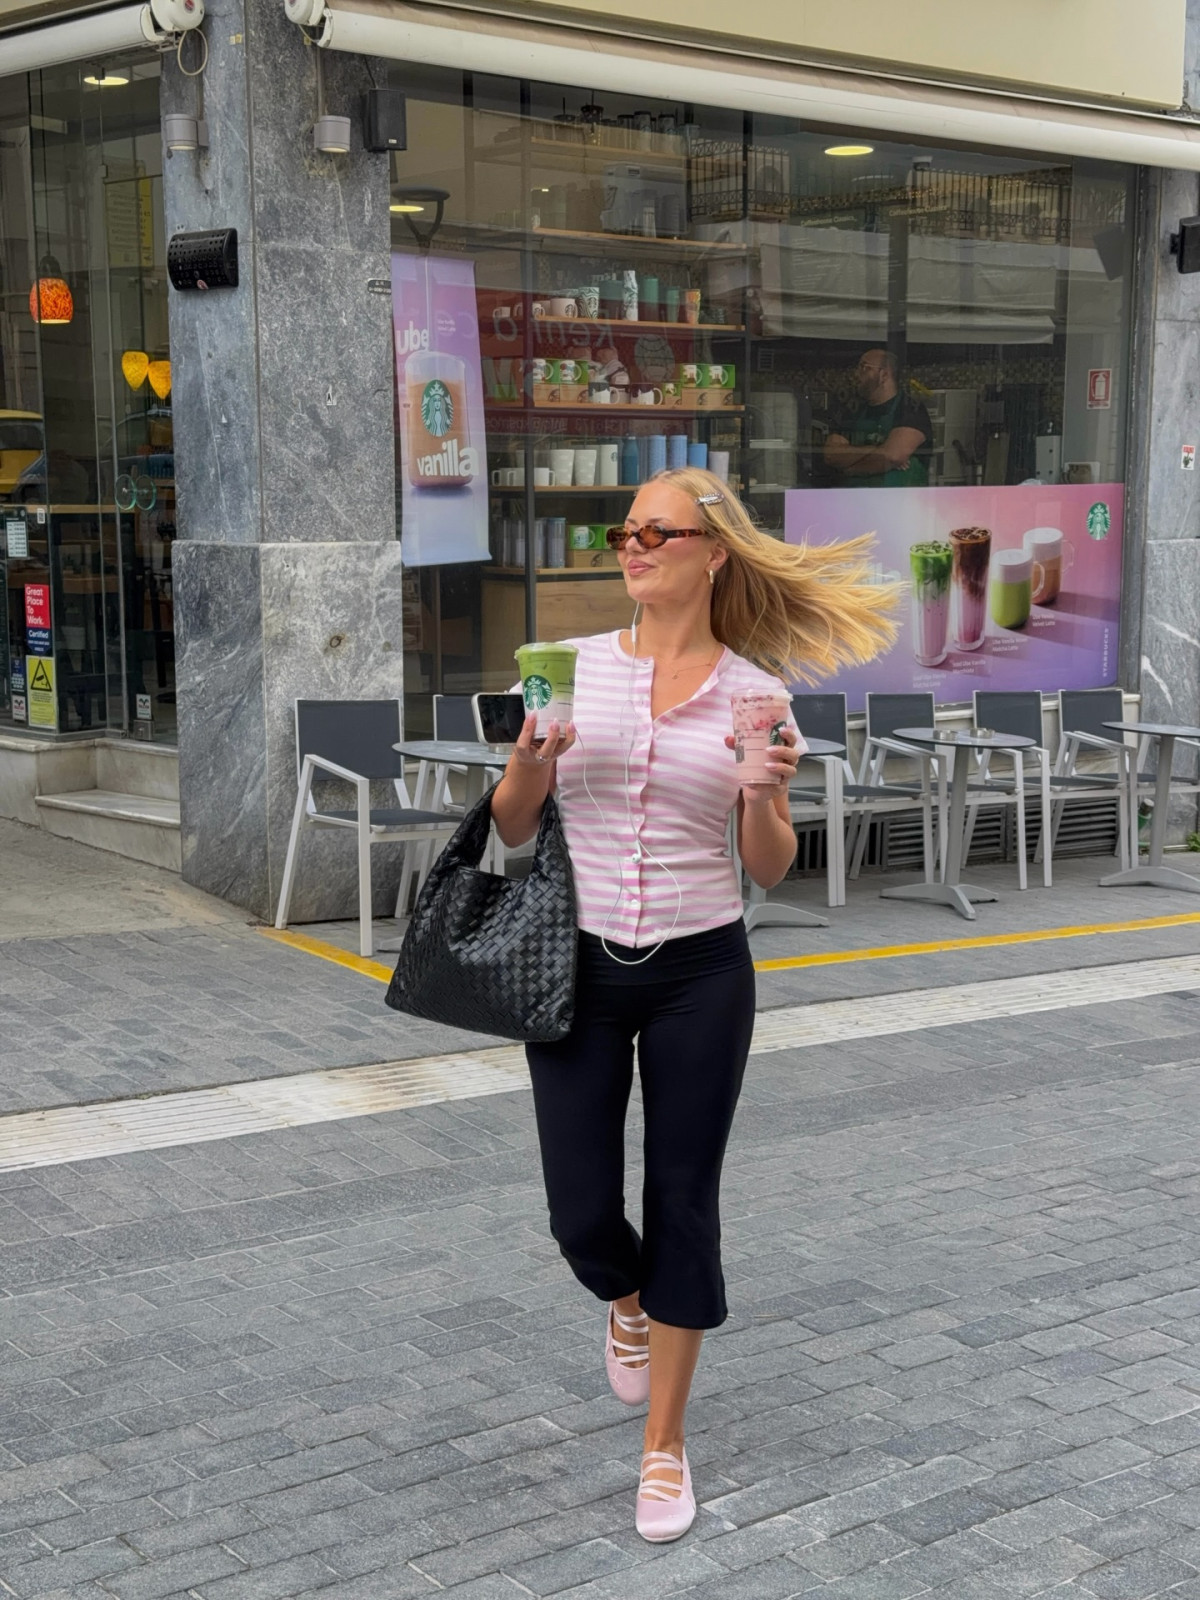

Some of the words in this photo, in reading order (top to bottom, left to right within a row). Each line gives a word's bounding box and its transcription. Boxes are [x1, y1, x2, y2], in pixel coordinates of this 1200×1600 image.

[396, 320, 430, 355] ube
[417, 439, 480, 477] vanilla
[26, 587, 43, 596] Great
[26, 596, 43, 606] Place
[27, 606, 34, 614] To
[27, 615, 44, 625] Work.
[28, 630, 49, 639] Certified
